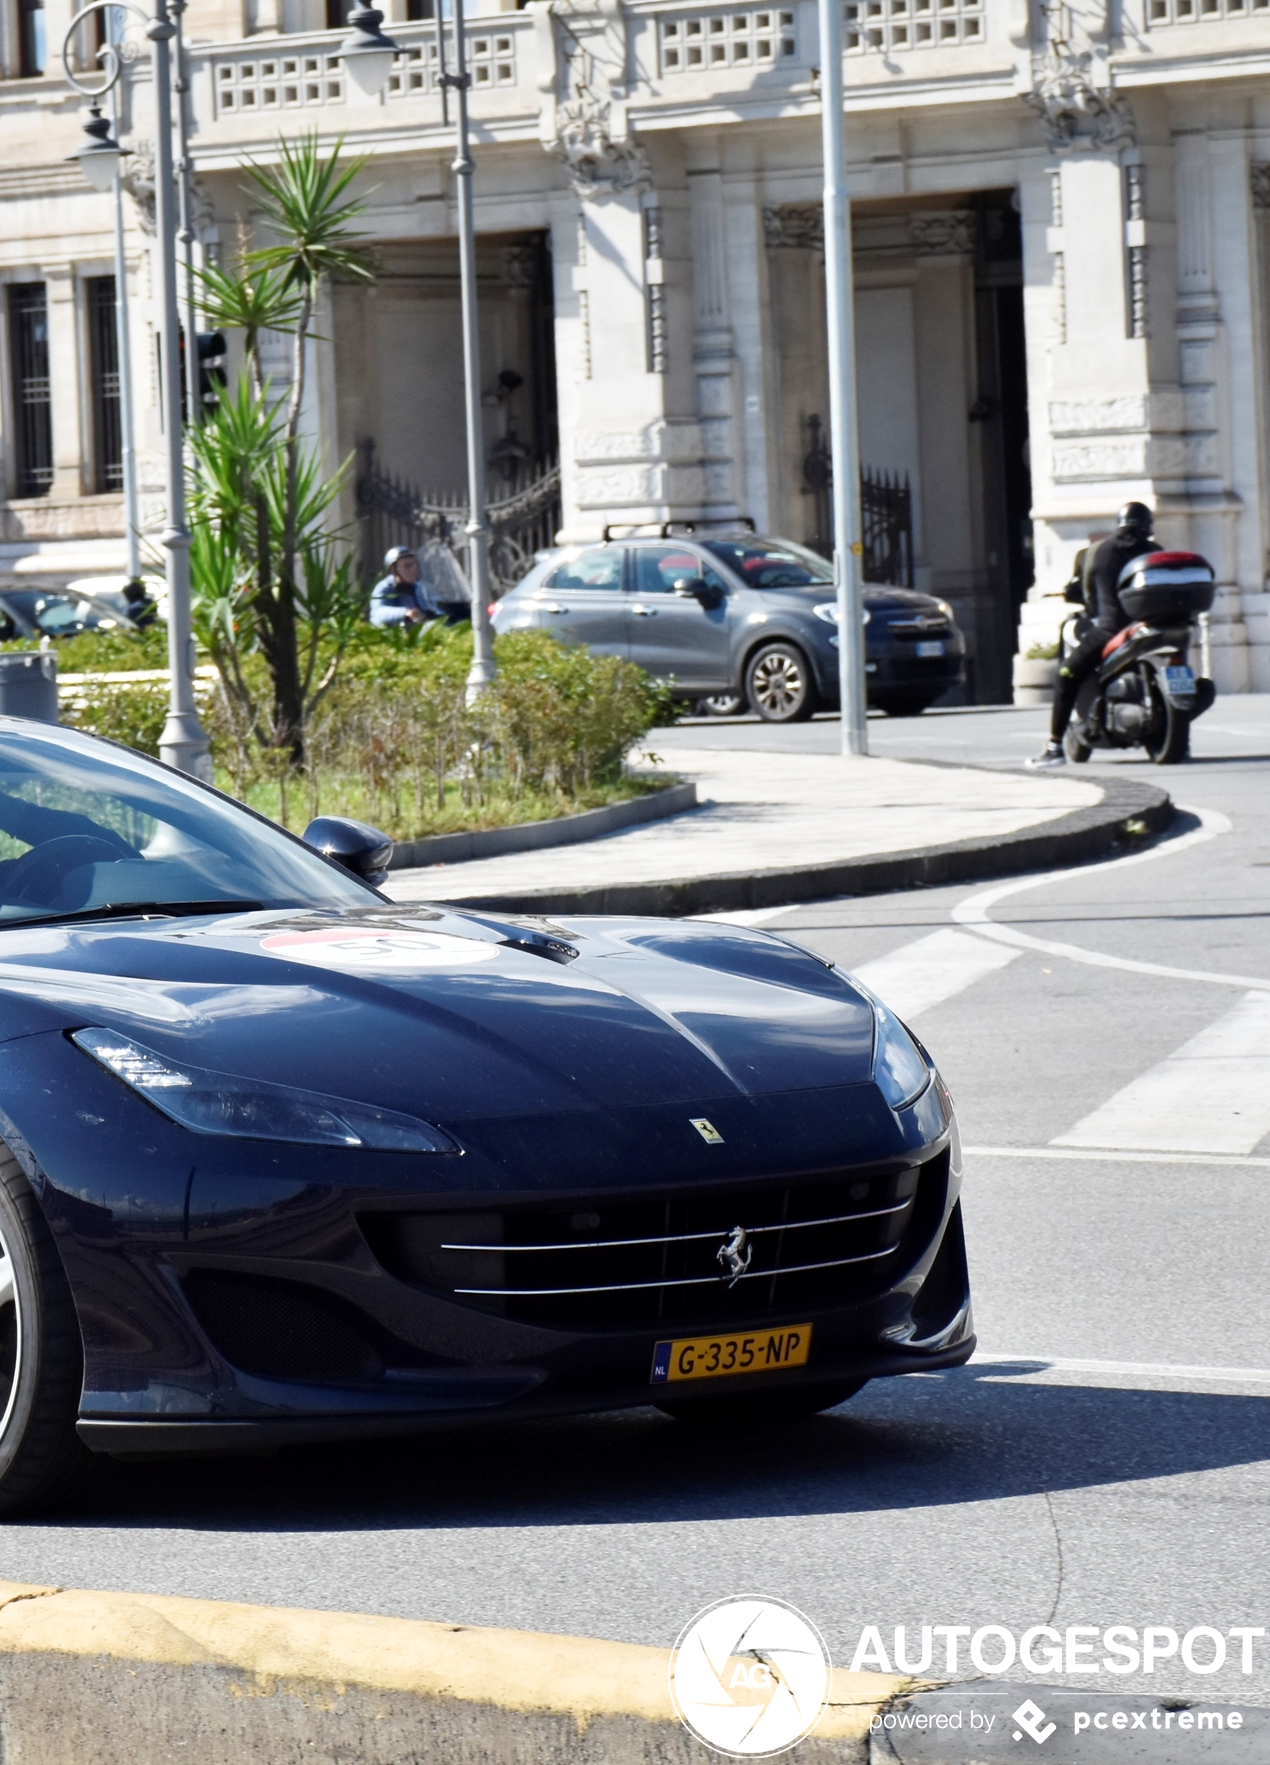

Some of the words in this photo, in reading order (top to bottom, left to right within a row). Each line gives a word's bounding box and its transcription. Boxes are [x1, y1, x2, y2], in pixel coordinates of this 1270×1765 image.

[327, 938, 441, 956] 50
[678, 1333, 800, 1375] G-335-NP
[654, 1366, 666, 1376] NL
